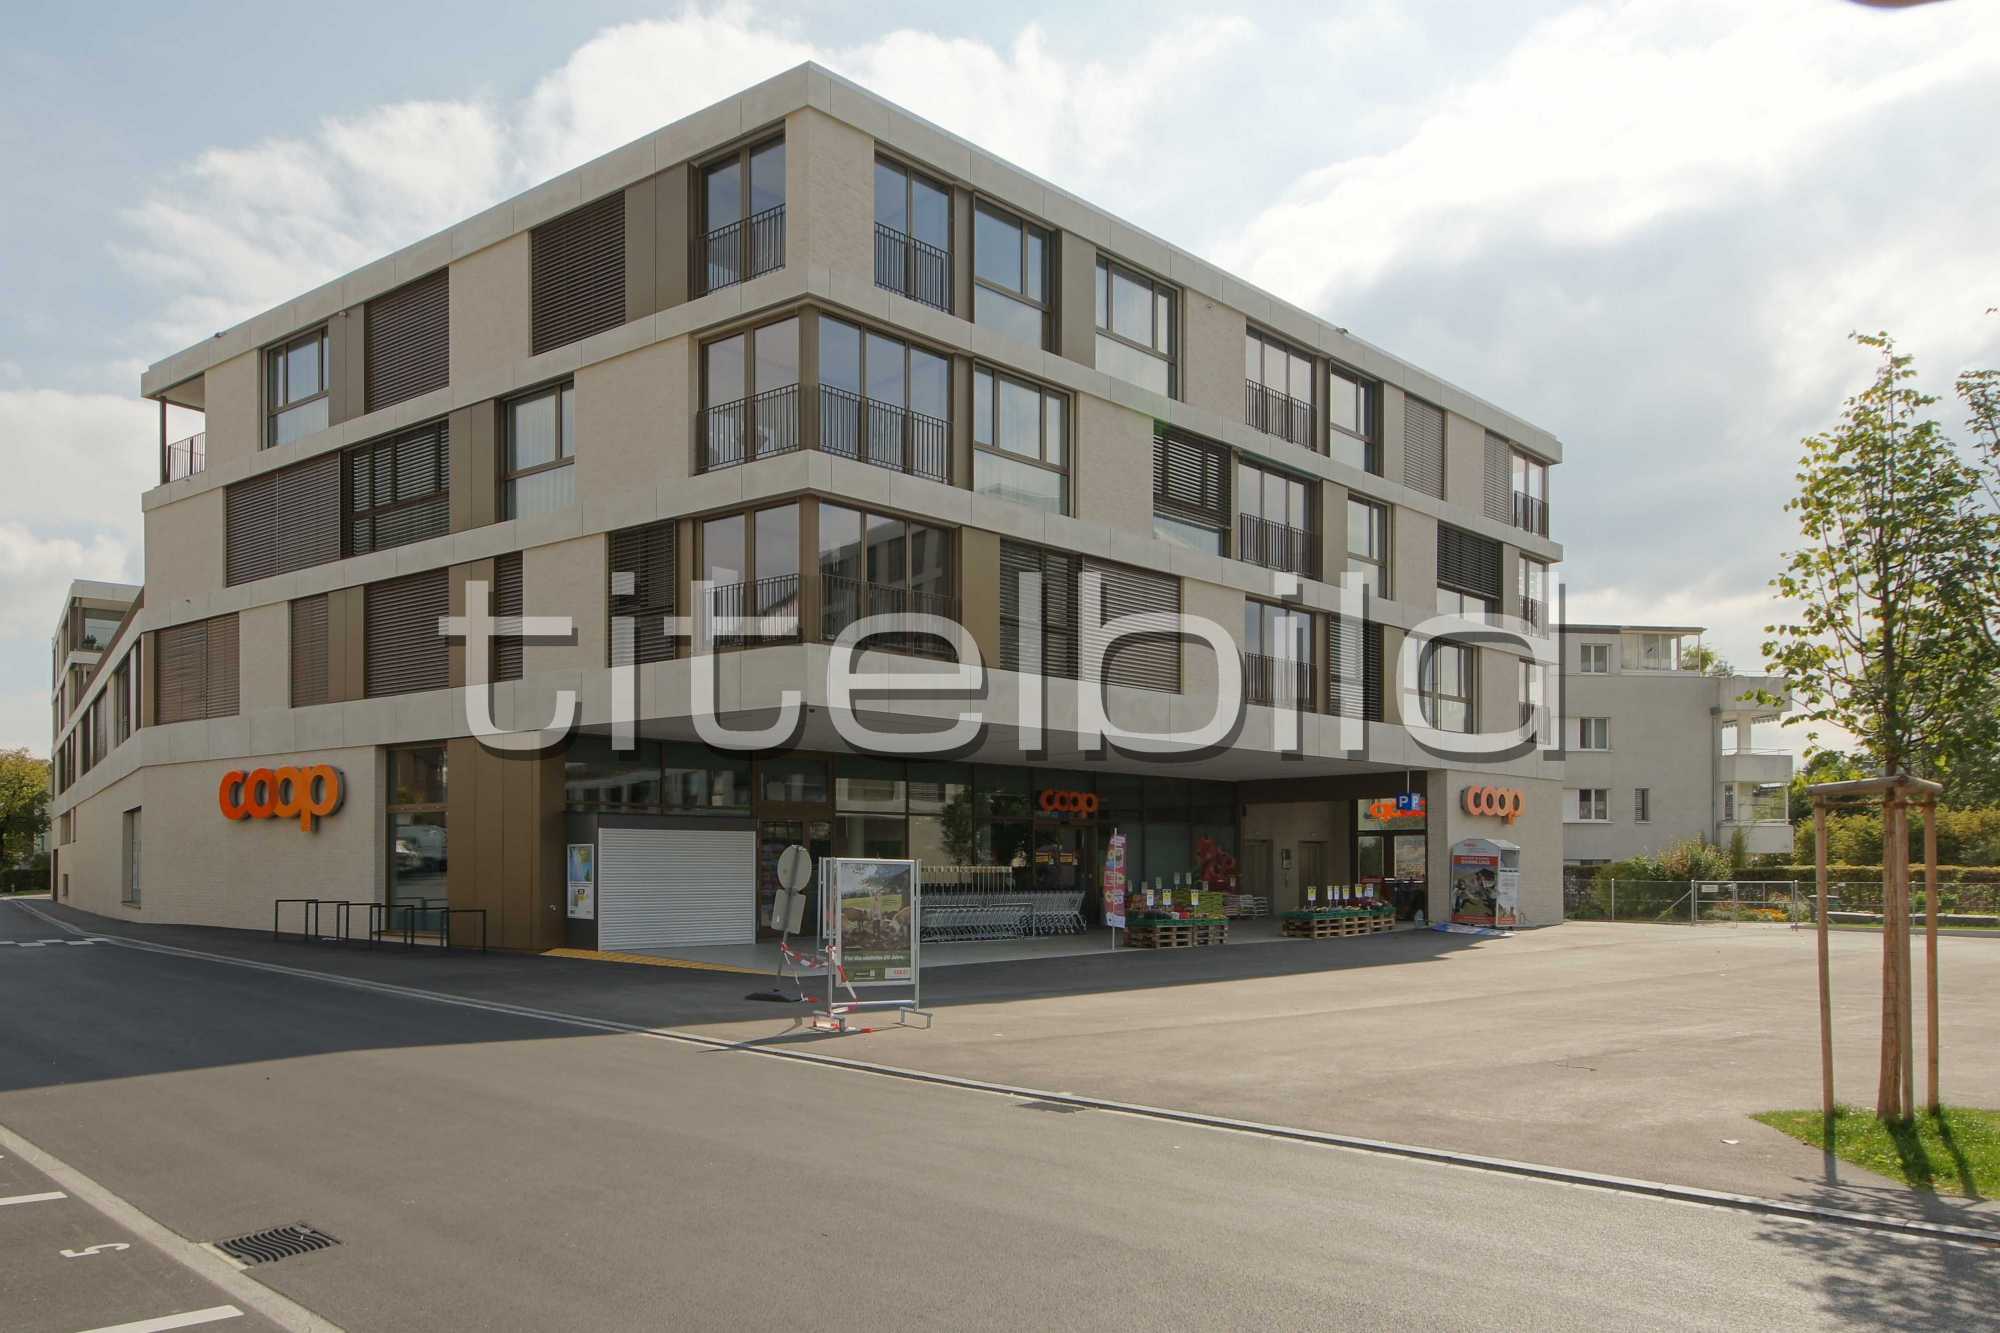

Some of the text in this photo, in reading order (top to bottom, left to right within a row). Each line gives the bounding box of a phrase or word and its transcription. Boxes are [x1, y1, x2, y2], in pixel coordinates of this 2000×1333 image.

[219, 764, 340, 833] coop
[1039, 788, 1099, 818] coop
[1467, 785, 1525, 826] coop
